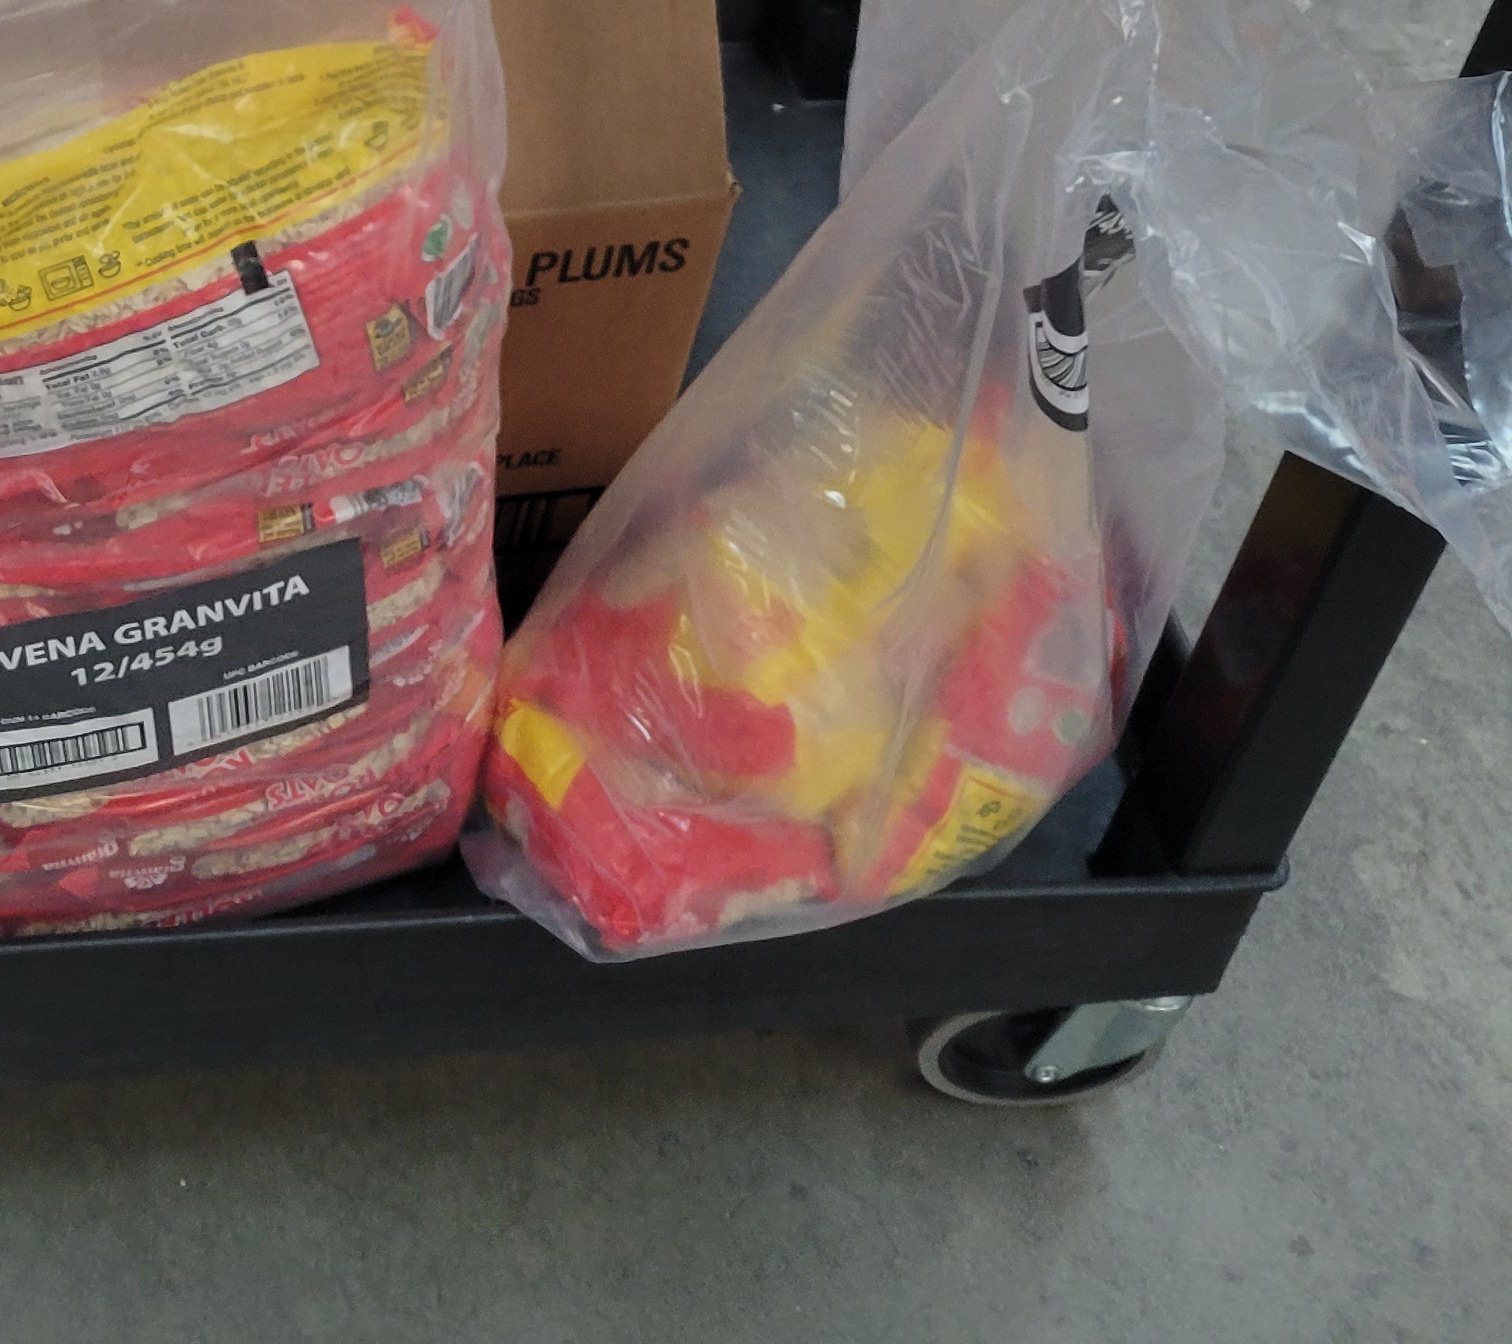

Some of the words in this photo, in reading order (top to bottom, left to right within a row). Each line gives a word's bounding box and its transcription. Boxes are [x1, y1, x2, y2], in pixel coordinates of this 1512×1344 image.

[525, 238, 691, 288] PLUMS
[112, 574, 312, 644] GRANVITA
[69, 632, 224, 688] 12/454g
